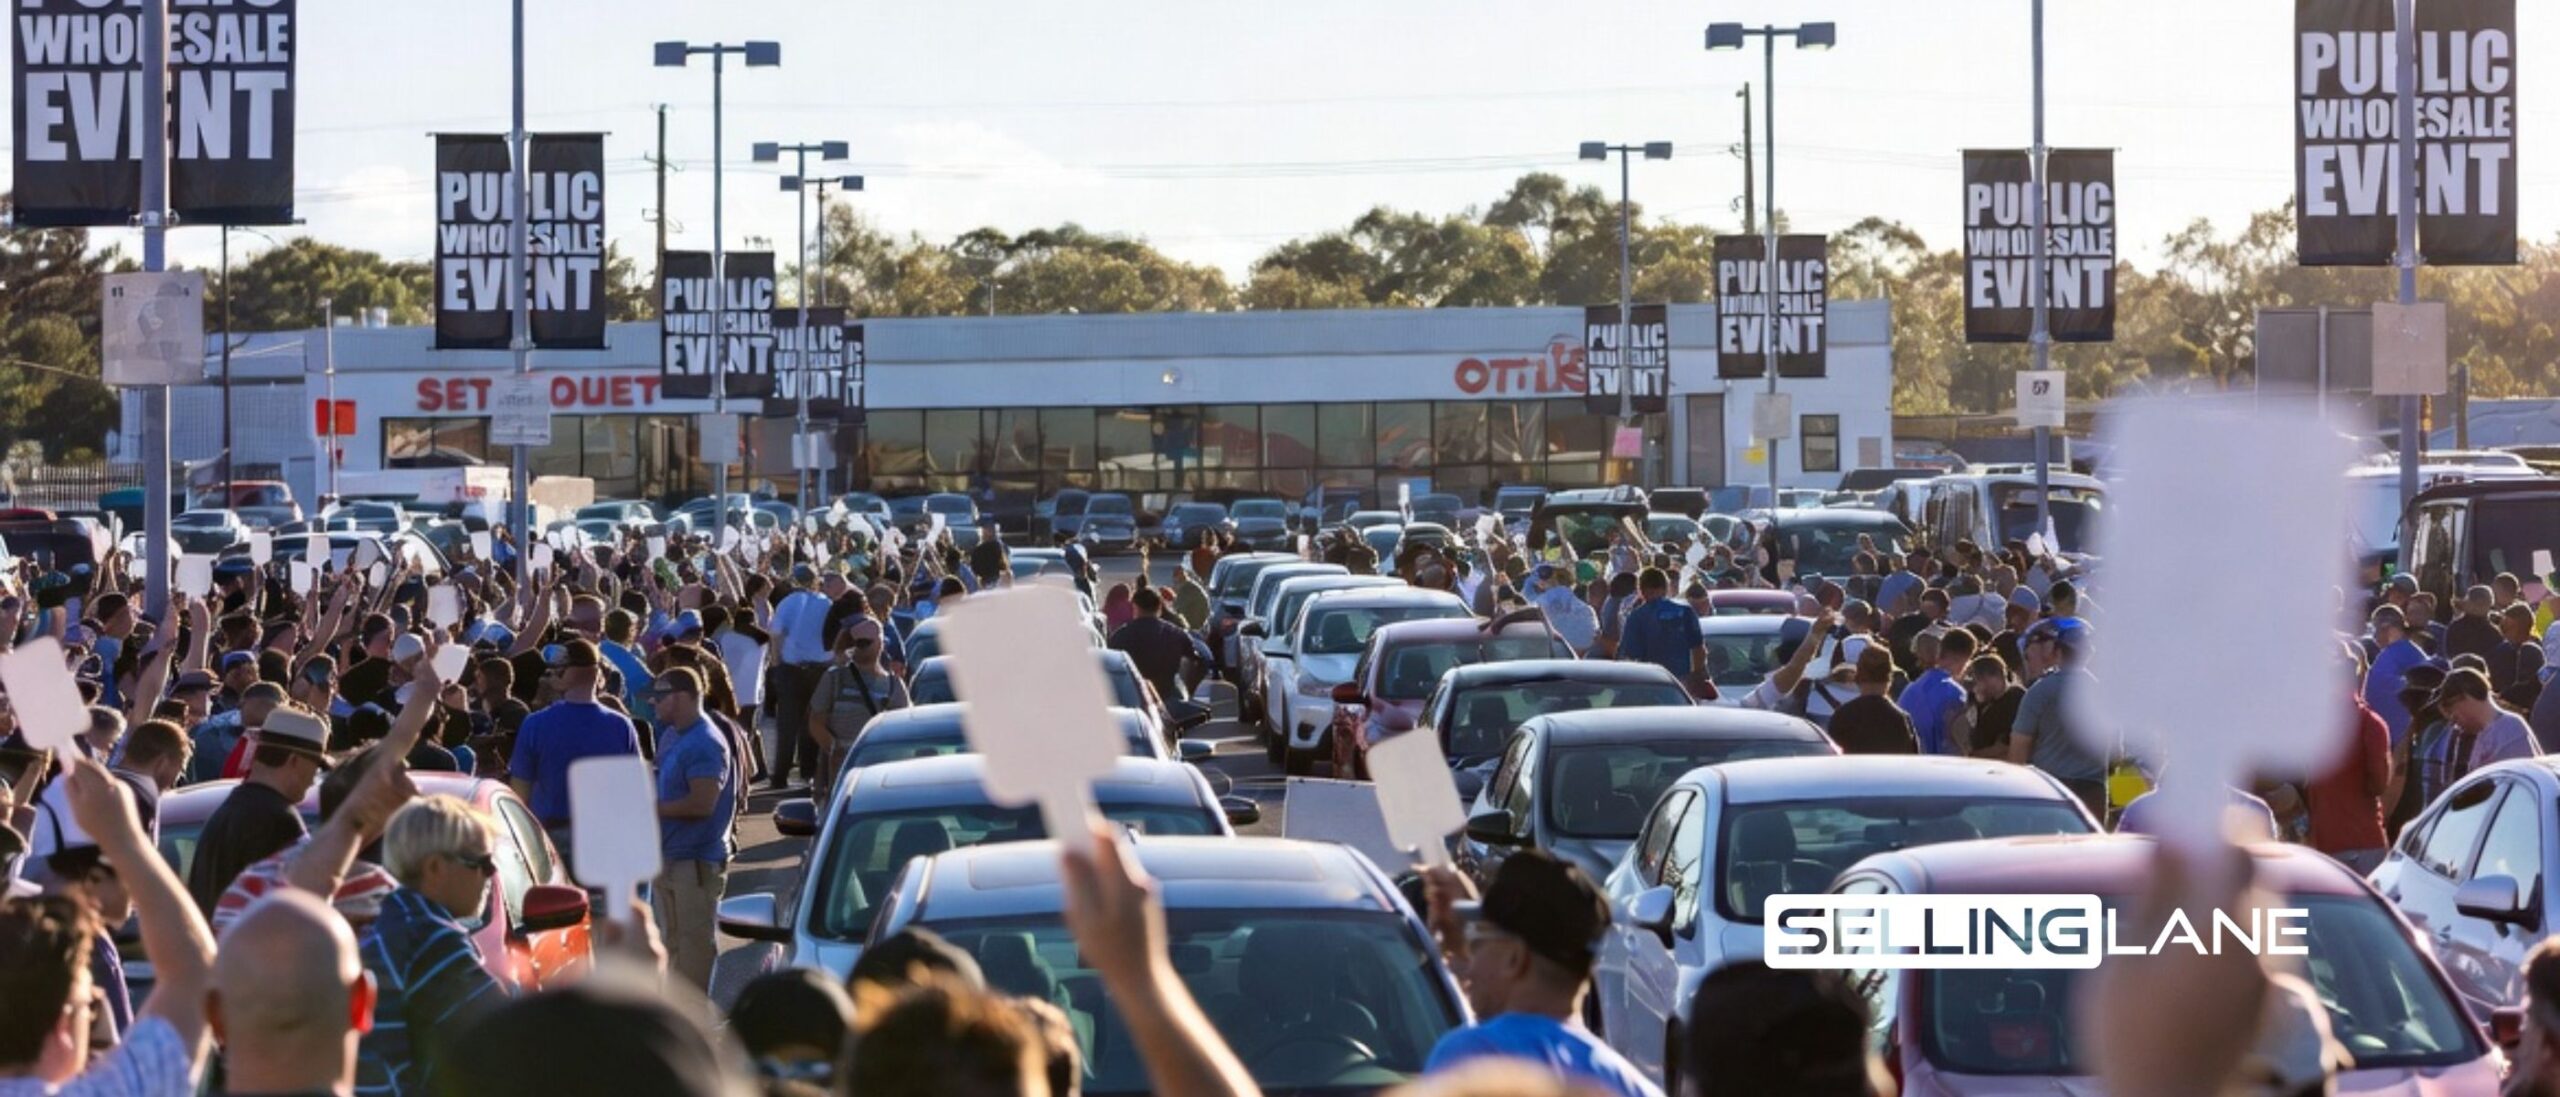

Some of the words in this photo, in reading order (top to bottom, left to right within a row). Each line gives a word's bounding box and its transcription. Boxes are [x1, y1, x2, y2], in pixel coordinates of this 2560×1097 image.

[1588, 323, 1665, 348] PULIC
[417, 377, 492, 411] SET
[1588, 368, 1665, 396] EVNT
